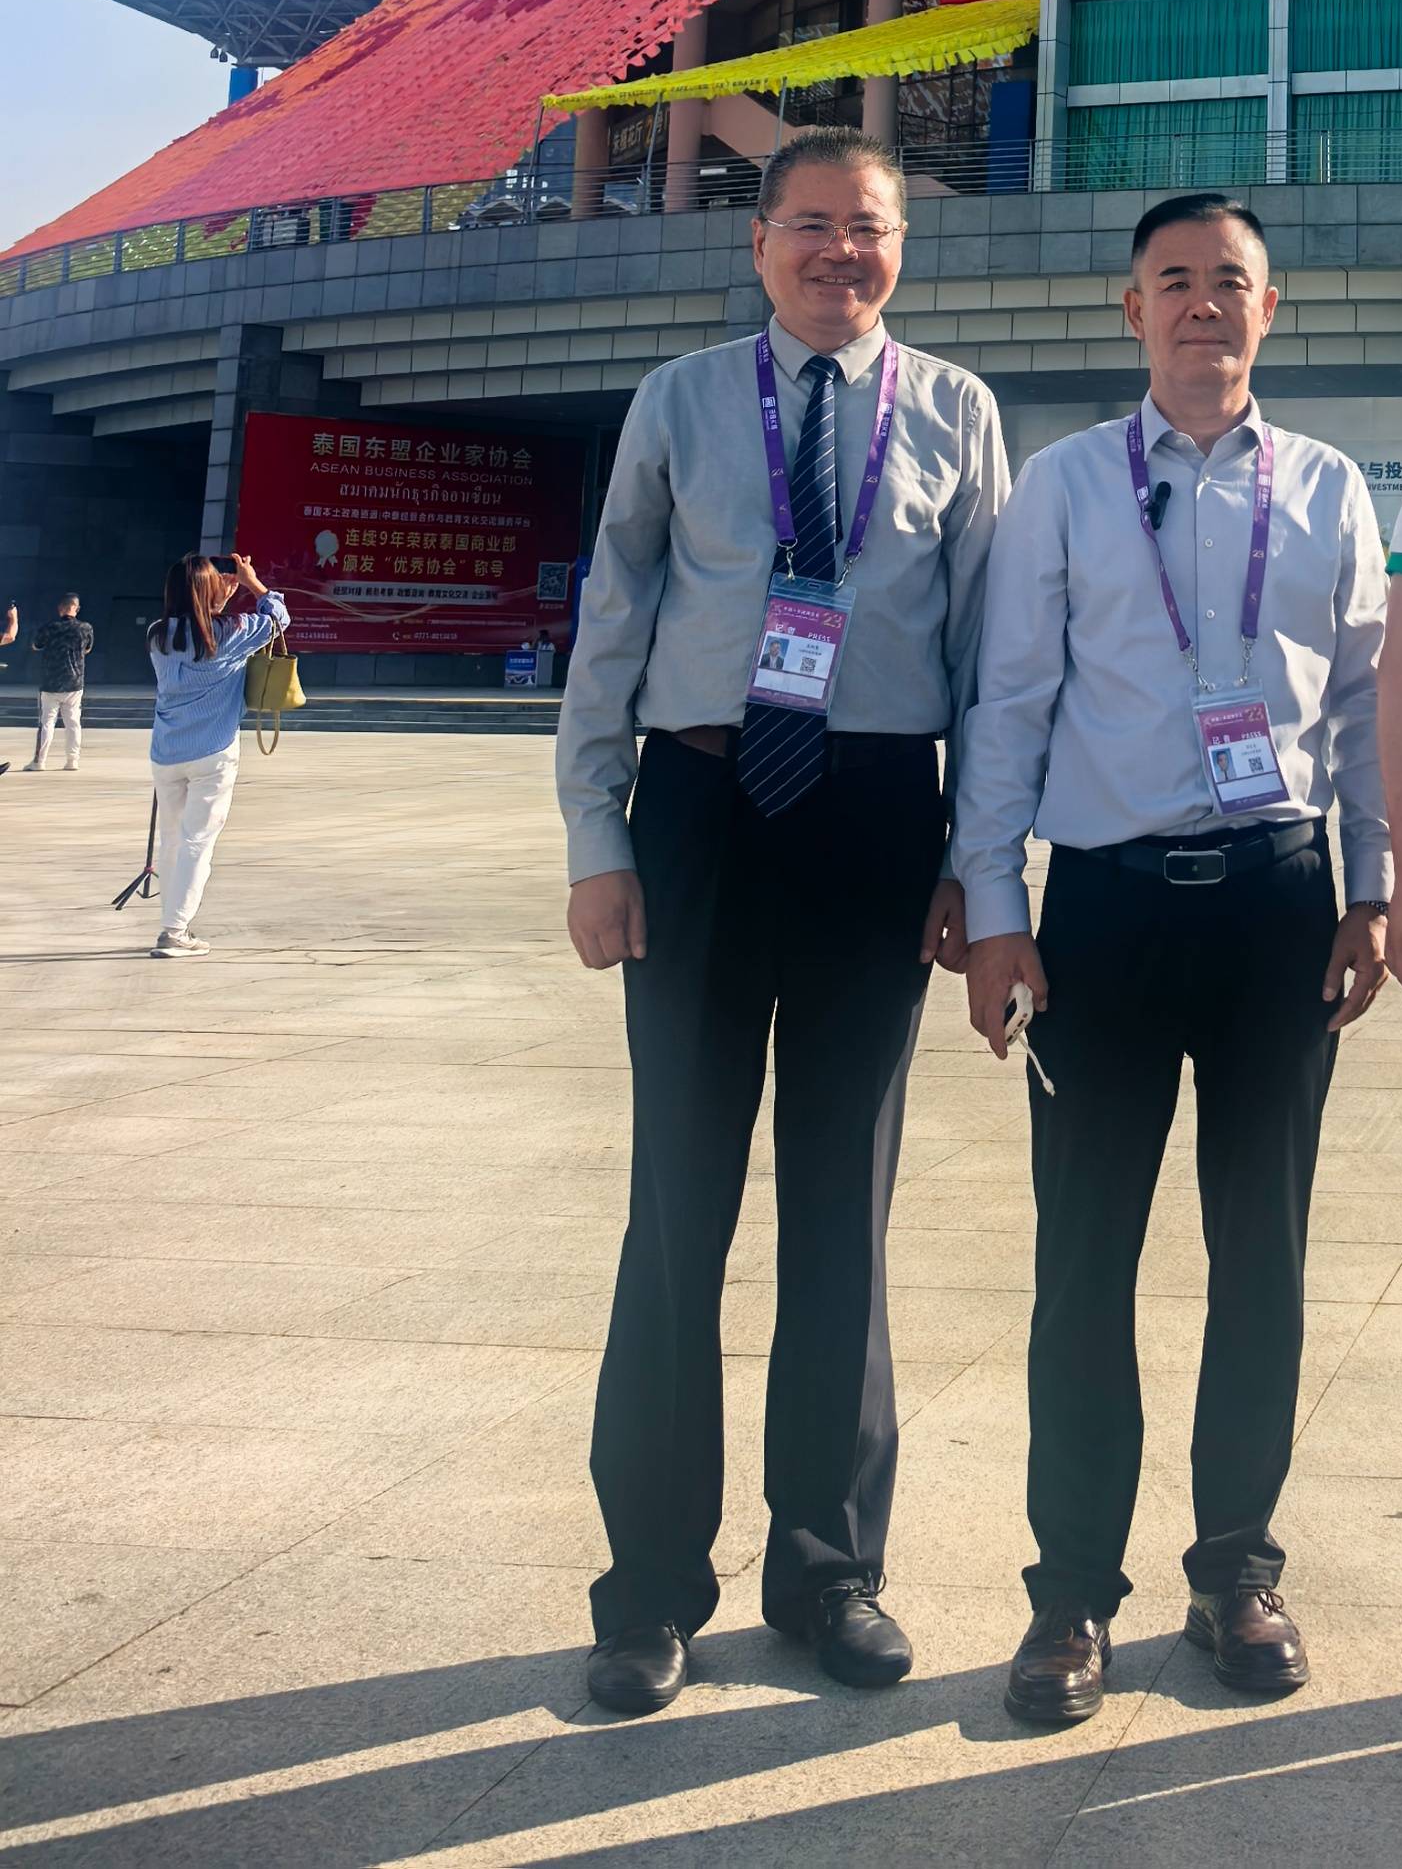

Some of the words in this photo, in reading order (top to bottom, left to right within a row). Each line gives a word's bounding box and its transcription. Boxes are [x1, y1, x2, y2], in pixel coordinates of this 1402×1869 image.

[311, 432, 534, 470] 泰国东盟企业家协会
[310, 461, 360, 475] ASEAN
[365, 465, 436, 480] BUSINESS
[442, 471, 534, 486] ASSOCIATION
[345, 528, 517, 554] 连续9年荣获泰国商业部
